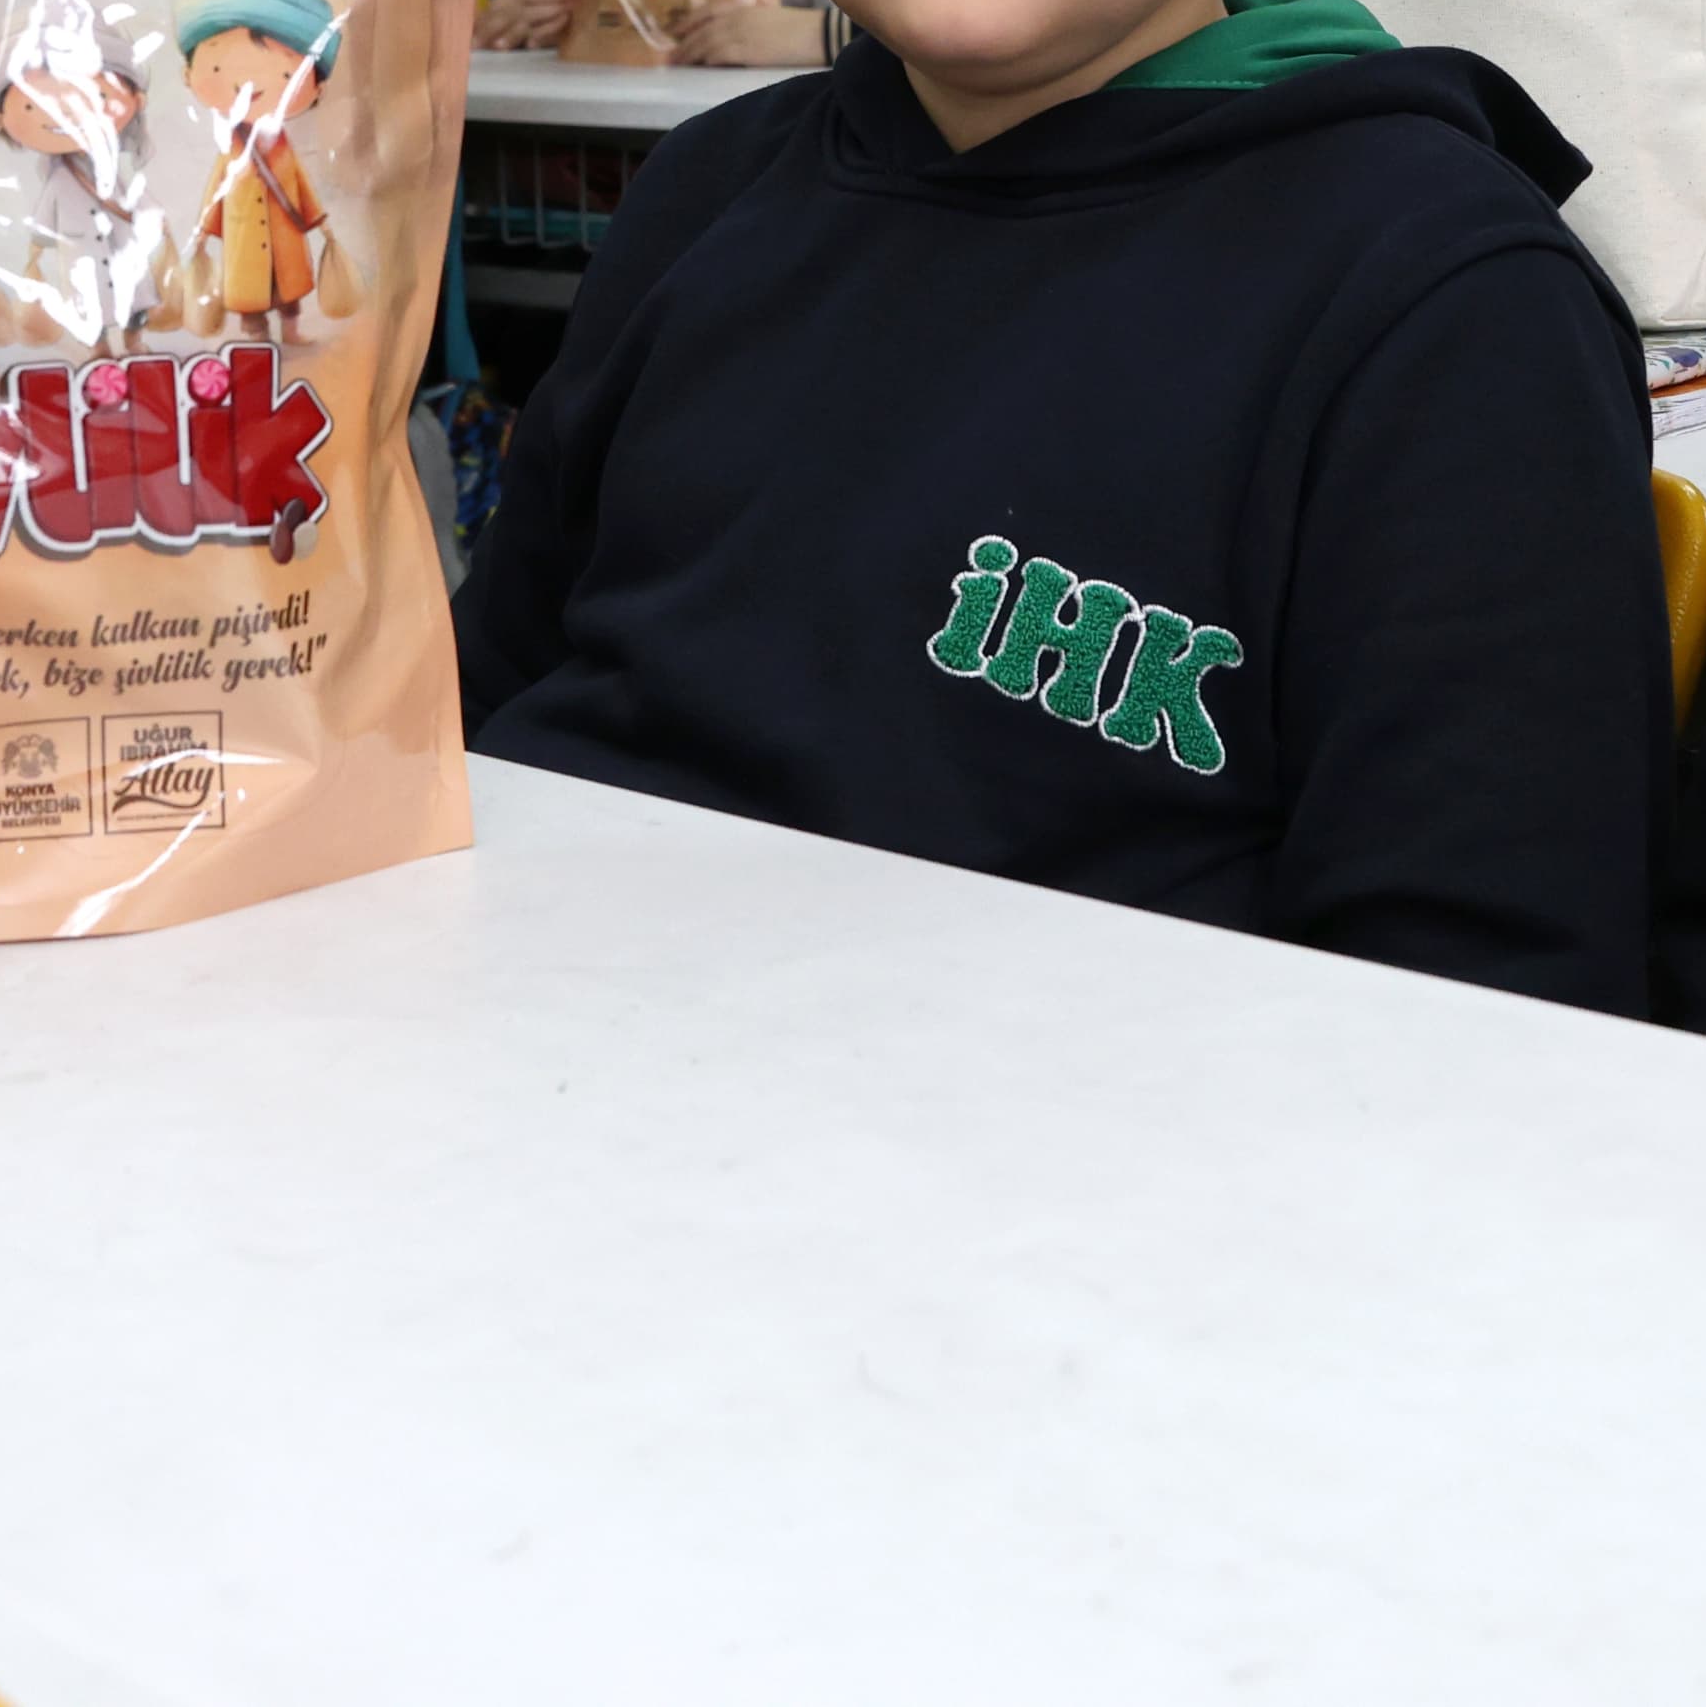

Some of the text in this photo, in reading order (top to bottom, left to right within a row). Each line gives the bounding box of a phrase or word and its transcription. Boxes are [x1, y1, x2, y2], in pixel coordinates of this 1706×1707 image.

[91, 609, 202, 648] kalkan
[210, 590, 311, 649] pişirdi!
[43, 657, 104, 697] bize
[114, 648, 215, 696] şivlilik
